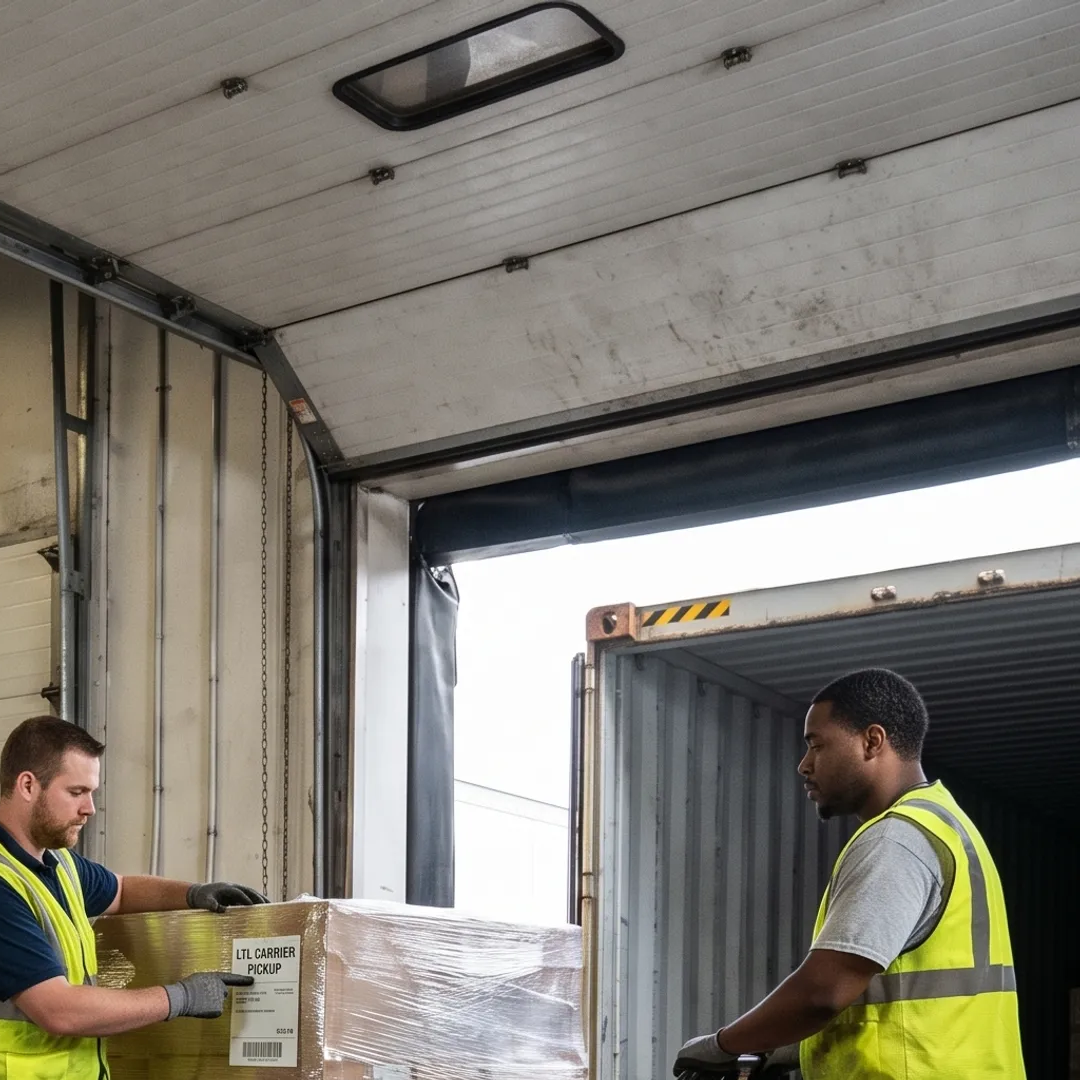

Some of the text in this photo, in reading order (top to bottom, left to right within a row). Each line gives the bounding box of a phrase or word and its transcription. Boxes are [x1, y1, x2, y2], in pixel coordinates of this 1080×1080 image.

[236, 946, 296, 960] LTL CARRIER
[247, 962, 282, 975] PICKUP
